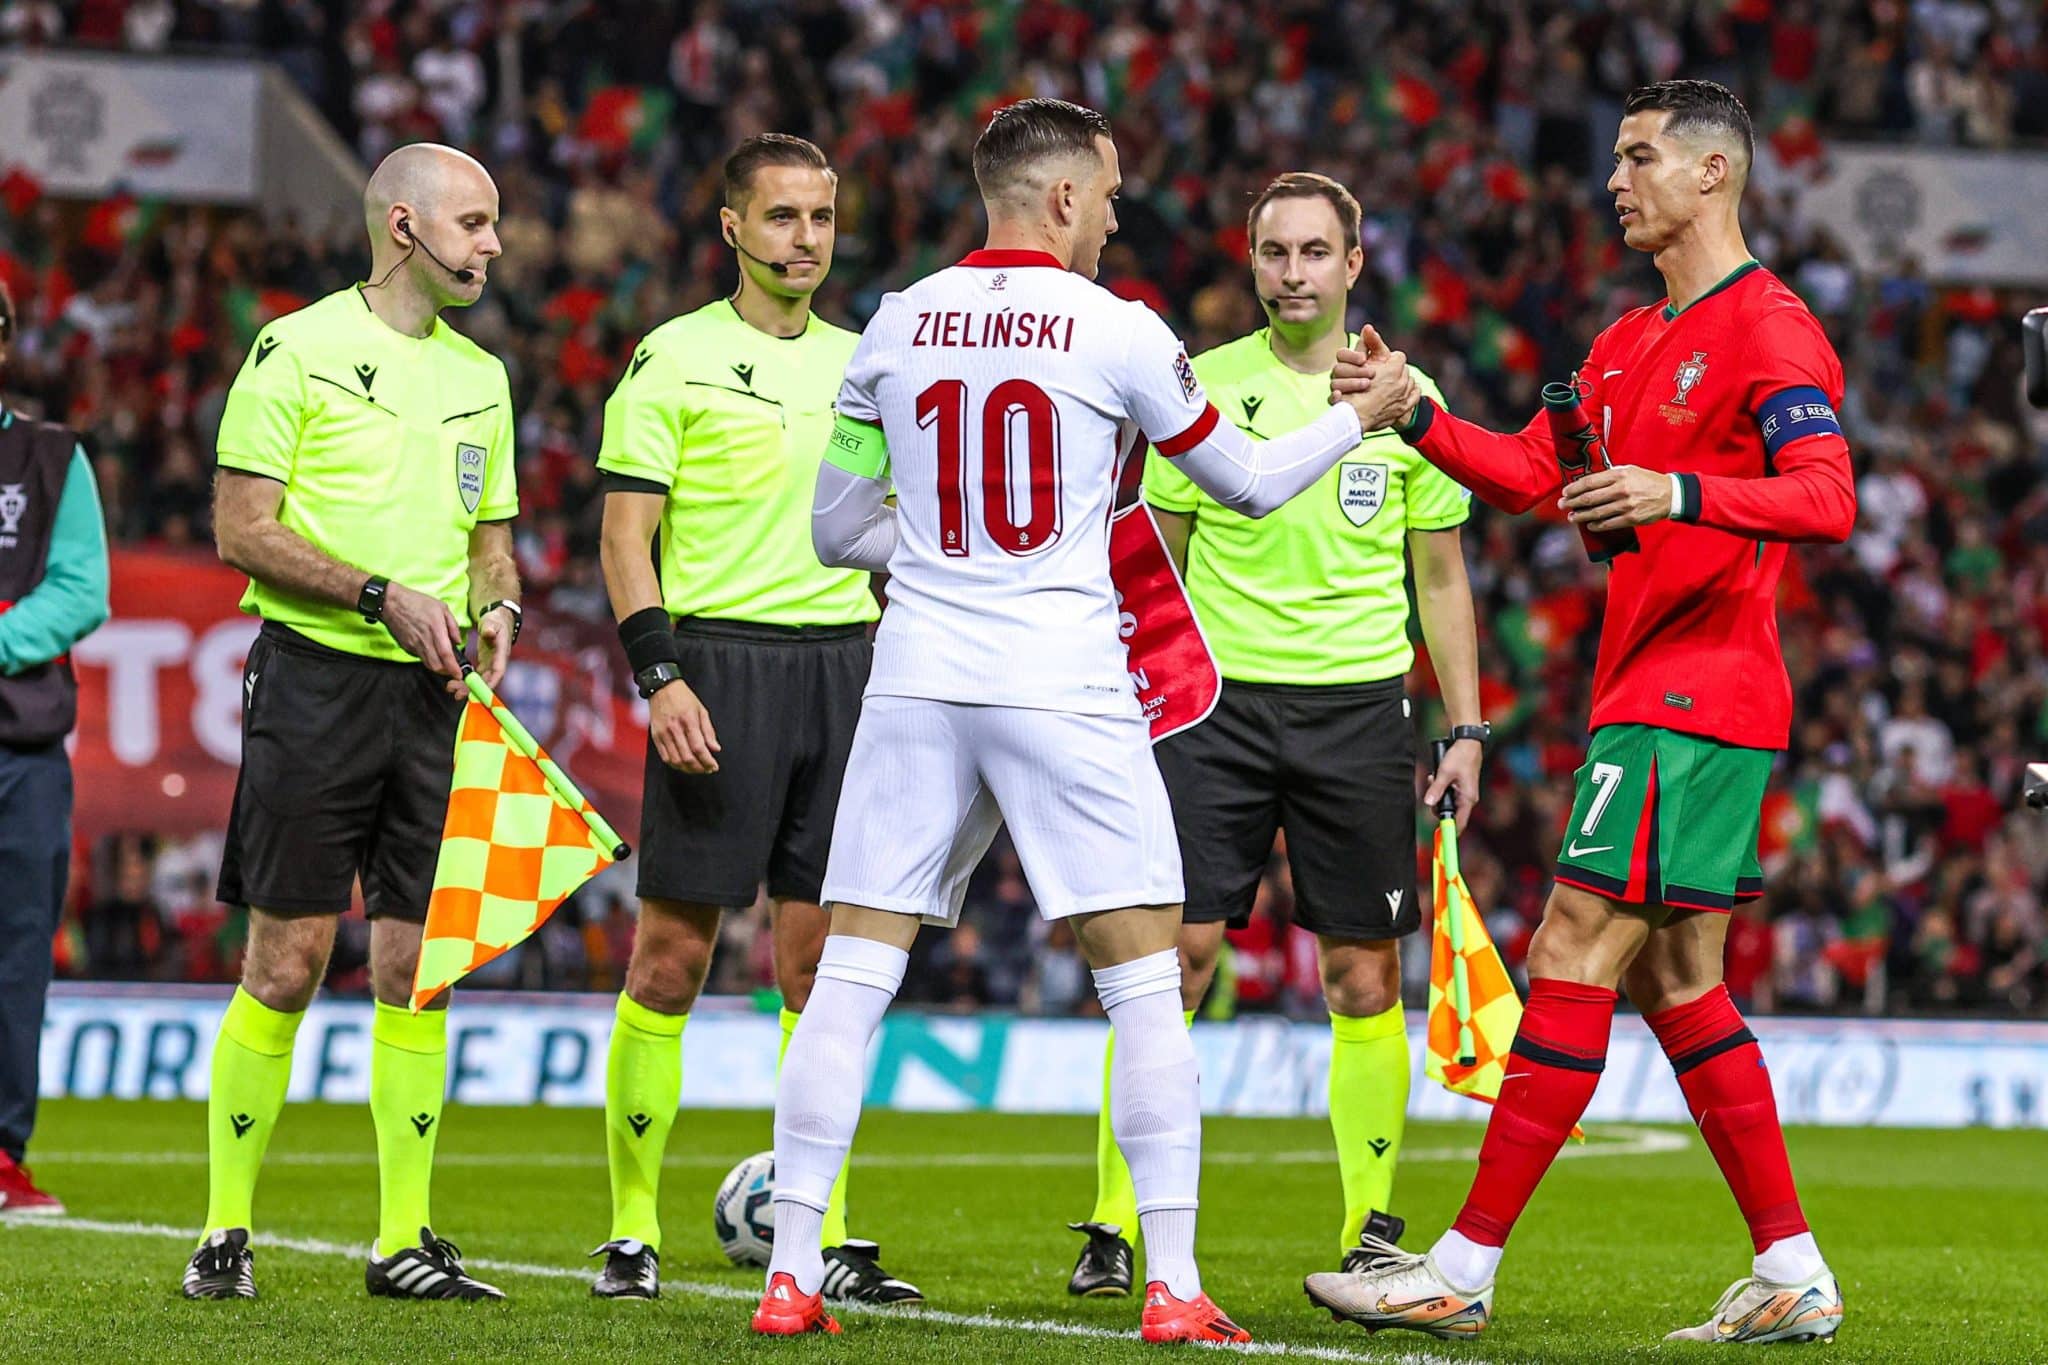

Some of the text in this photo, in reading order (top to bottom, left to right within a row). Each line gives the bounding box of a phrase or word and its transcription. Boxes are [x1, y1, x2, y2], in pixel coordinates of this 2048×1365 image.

[912, 306, 1074, 352] ZIELIŃSKI
[916, 378, 1063, 557] 10
[463, 472, 479, 482] MATCH
[1348, 470, 1378, 482] UEFA
[461, 482, 480, 493] OFFICIAL
[1349, 489, 1376, 497] MATCH
[1344, 498, 1378, 507] OFFICIAL
[1581, 762, 1624, 837] 7
